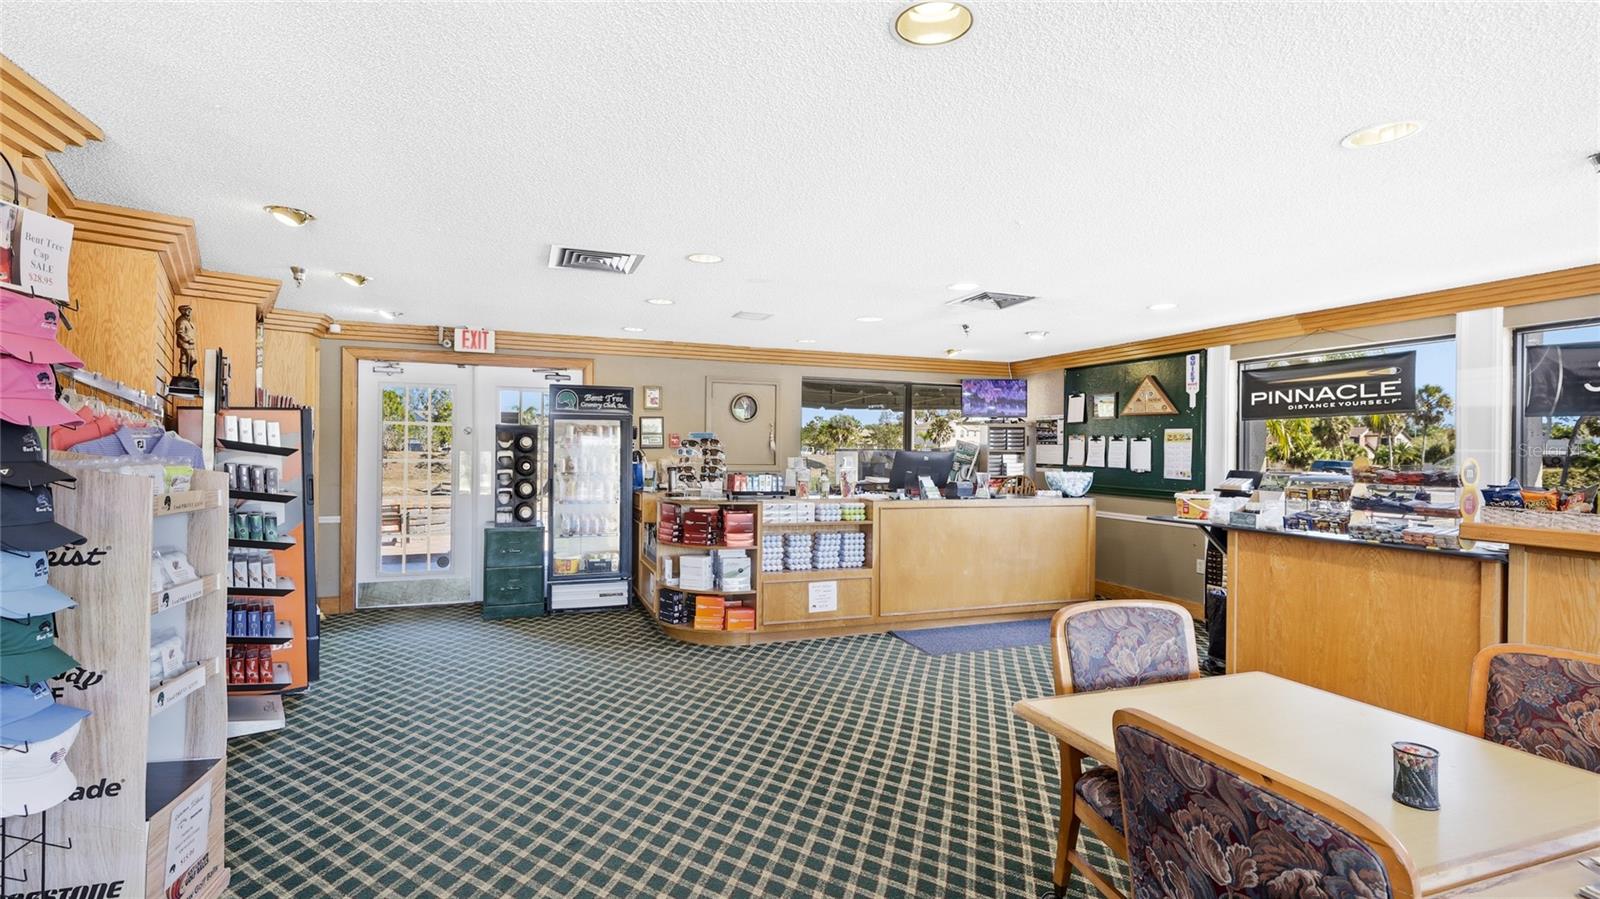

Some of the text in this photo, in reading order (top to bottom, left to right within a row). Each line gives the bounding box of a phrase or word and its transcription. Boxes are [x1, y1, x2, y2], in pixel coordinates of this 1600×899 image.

[25, 232, 64, 252] Bent Tree
[33, 247, 49, 261] Cap
[31, 260, 54, 273] SALE
[462, 330, 489, 349] EXIT
[605, 393, 623, 402] Tree
[1251, 380, 1402, 406] PINNACLE
[1288, 398, 1397, 410] DISTANCE YOURSELF
